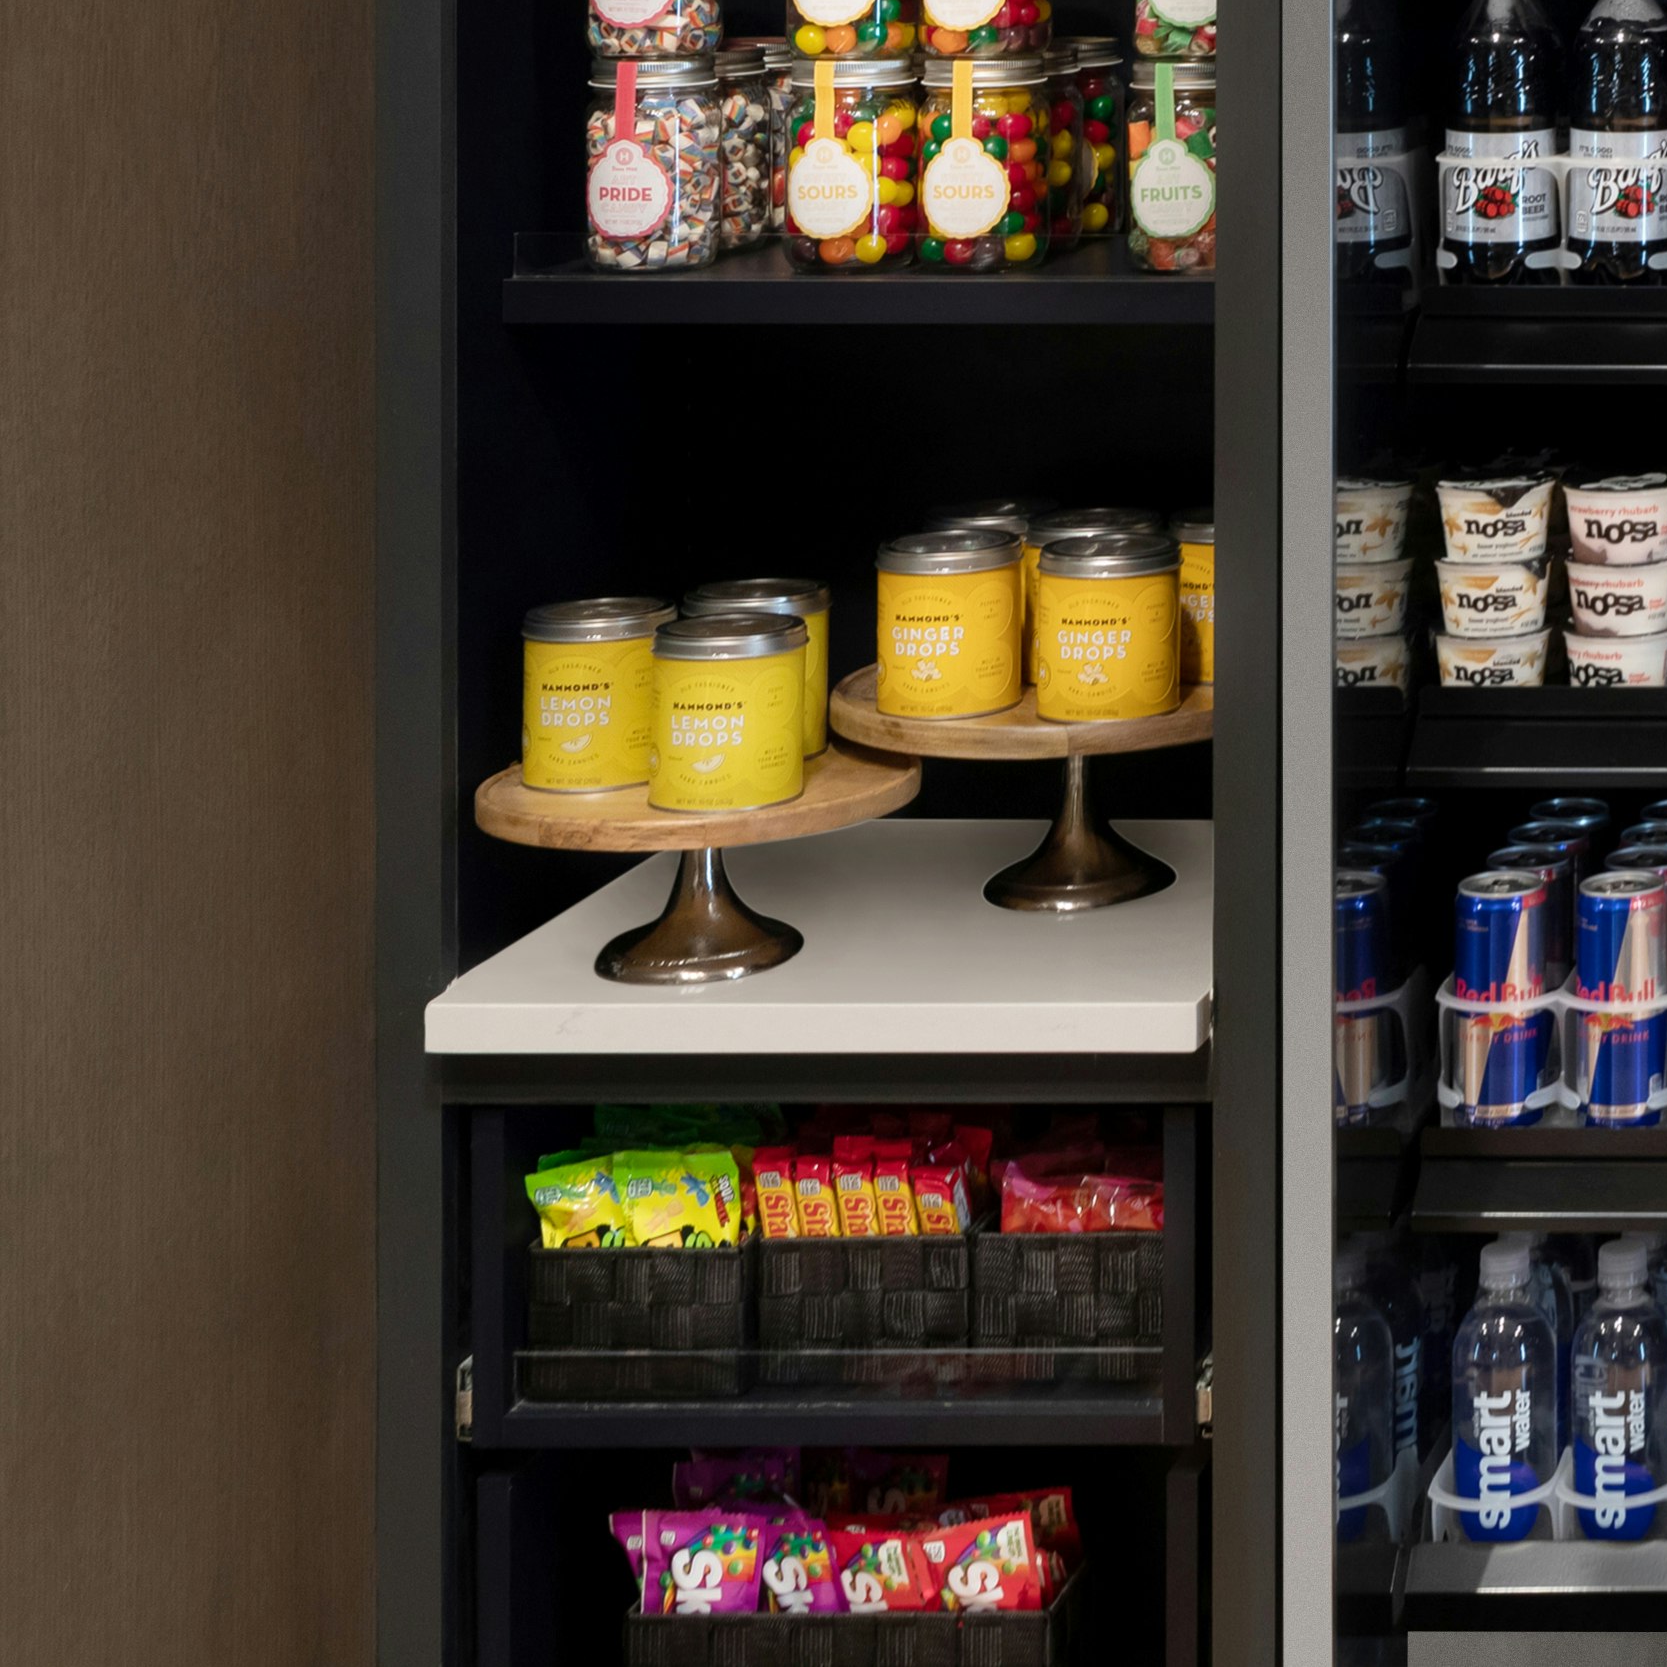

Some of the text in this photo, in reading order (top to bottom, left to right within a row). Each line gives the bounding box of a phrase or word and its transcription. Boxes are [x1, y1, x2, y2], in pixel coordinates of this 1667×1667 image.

[599, 187, 653, 202] PRIDE
[797, 183, 858, 200] SOURS
[932, 184, 995, 201] SOURS
[1140, 185, 1203, 203] FRUITS
[1522, 194, 1546, 204] ROOT
[1522, 204, 1546, 214] BEER
[1464, 517, 1528, 539] noosa
[1584, 518, 1659, 545] noosa
[1457, 591, 1519, 614] noosa
[1574, 589, 1647, 616] noosa
[895, 613, 961, 624] HAMMOND'S
[891, 626, 965, 641] GINGER
[1057, 629, 1132, 645] GINGER
[894, 641, 961, 657] DROPS
[1060, 644, 1127, 661] DROPS
[539, 695, 612, 712] LEMON
[540, 712, 610, 727] DROPS
[670, 714, 745, 731] LEMON
[671, 730, 743, 747] DROPS
[1514, 1388, 1531, 1453] water
[1629, 1388, 1646, 1453] water
[1475, 1389, 1511, 1529] smart
[1591, 1389, 1627, 1529] smart
